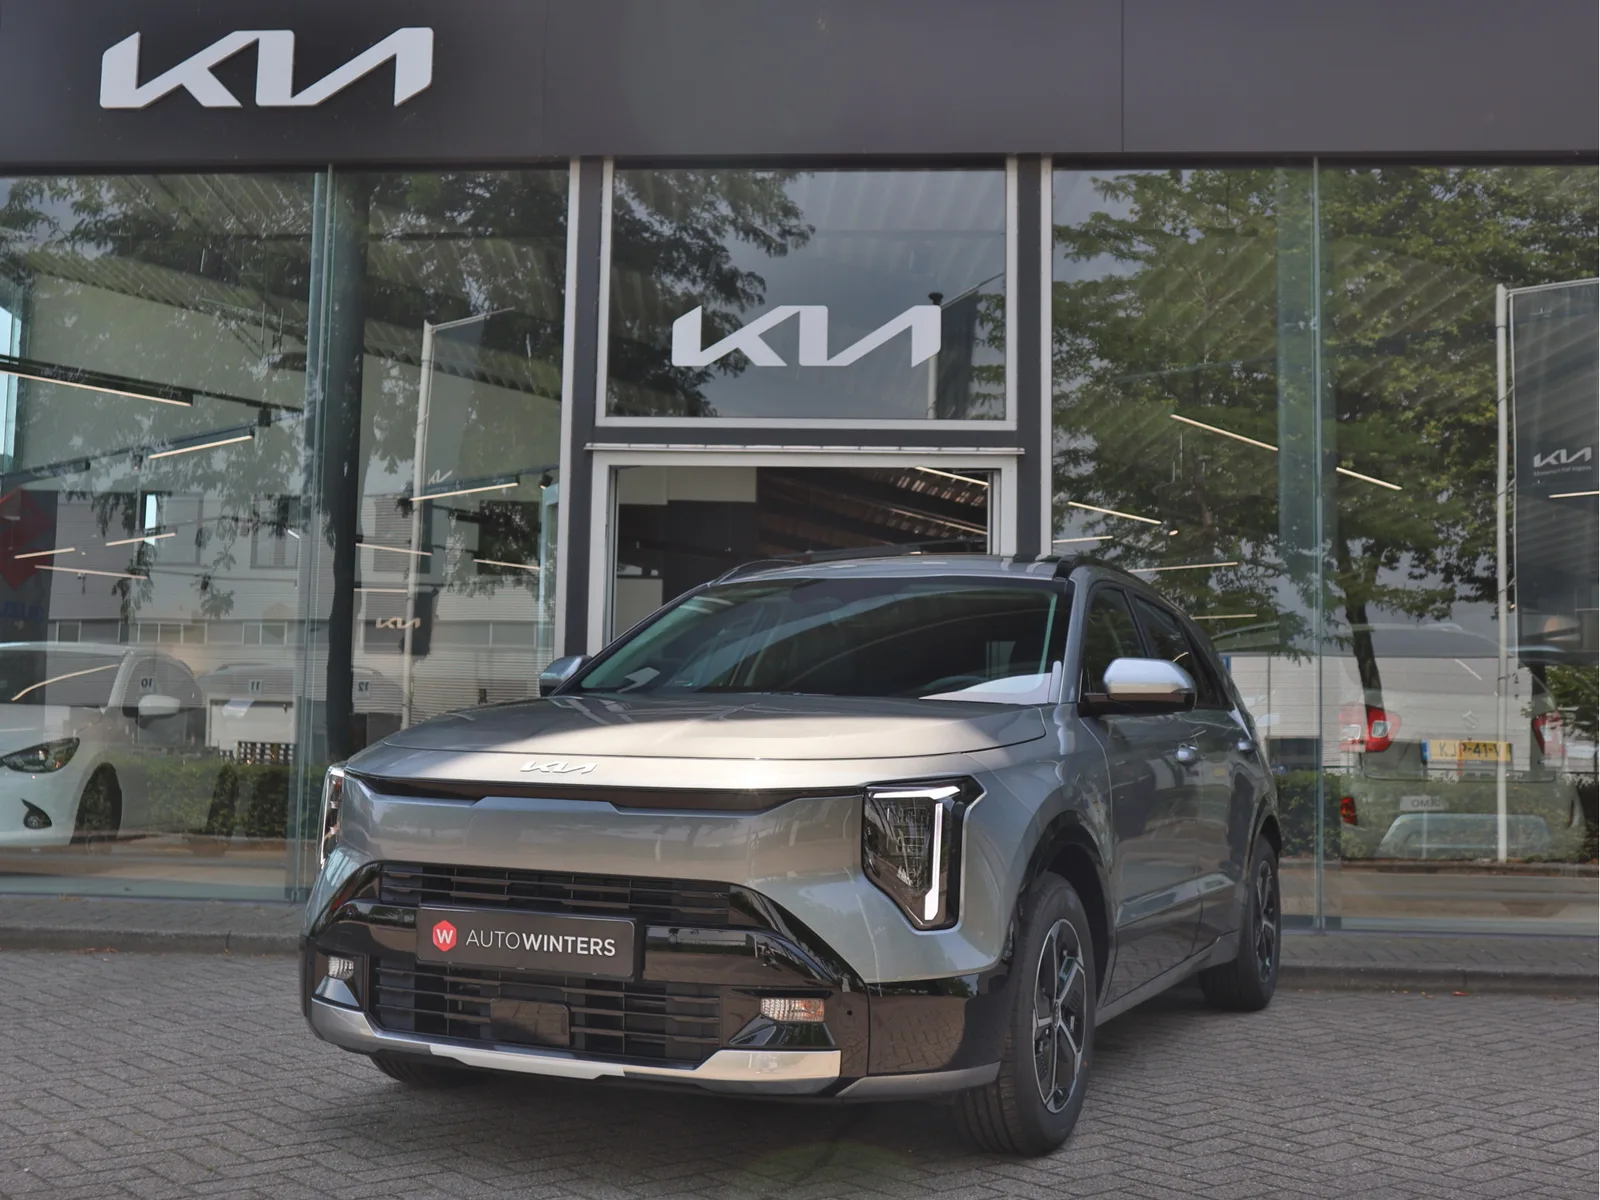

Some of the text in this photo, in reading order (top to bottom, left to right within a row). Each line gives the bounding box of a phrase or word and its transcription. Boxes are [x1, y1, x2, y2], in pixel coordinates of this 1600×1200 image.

[100, 27, 434, 108] KIA
[672, 305, 941, 367] KIA
[1533, 447, 1592, 468] KIA
[376, 617, 421, 629] KIA
[520, 760, 598, 775] KIA
[436, 929, 616, 957] W AUTOWINTERS
